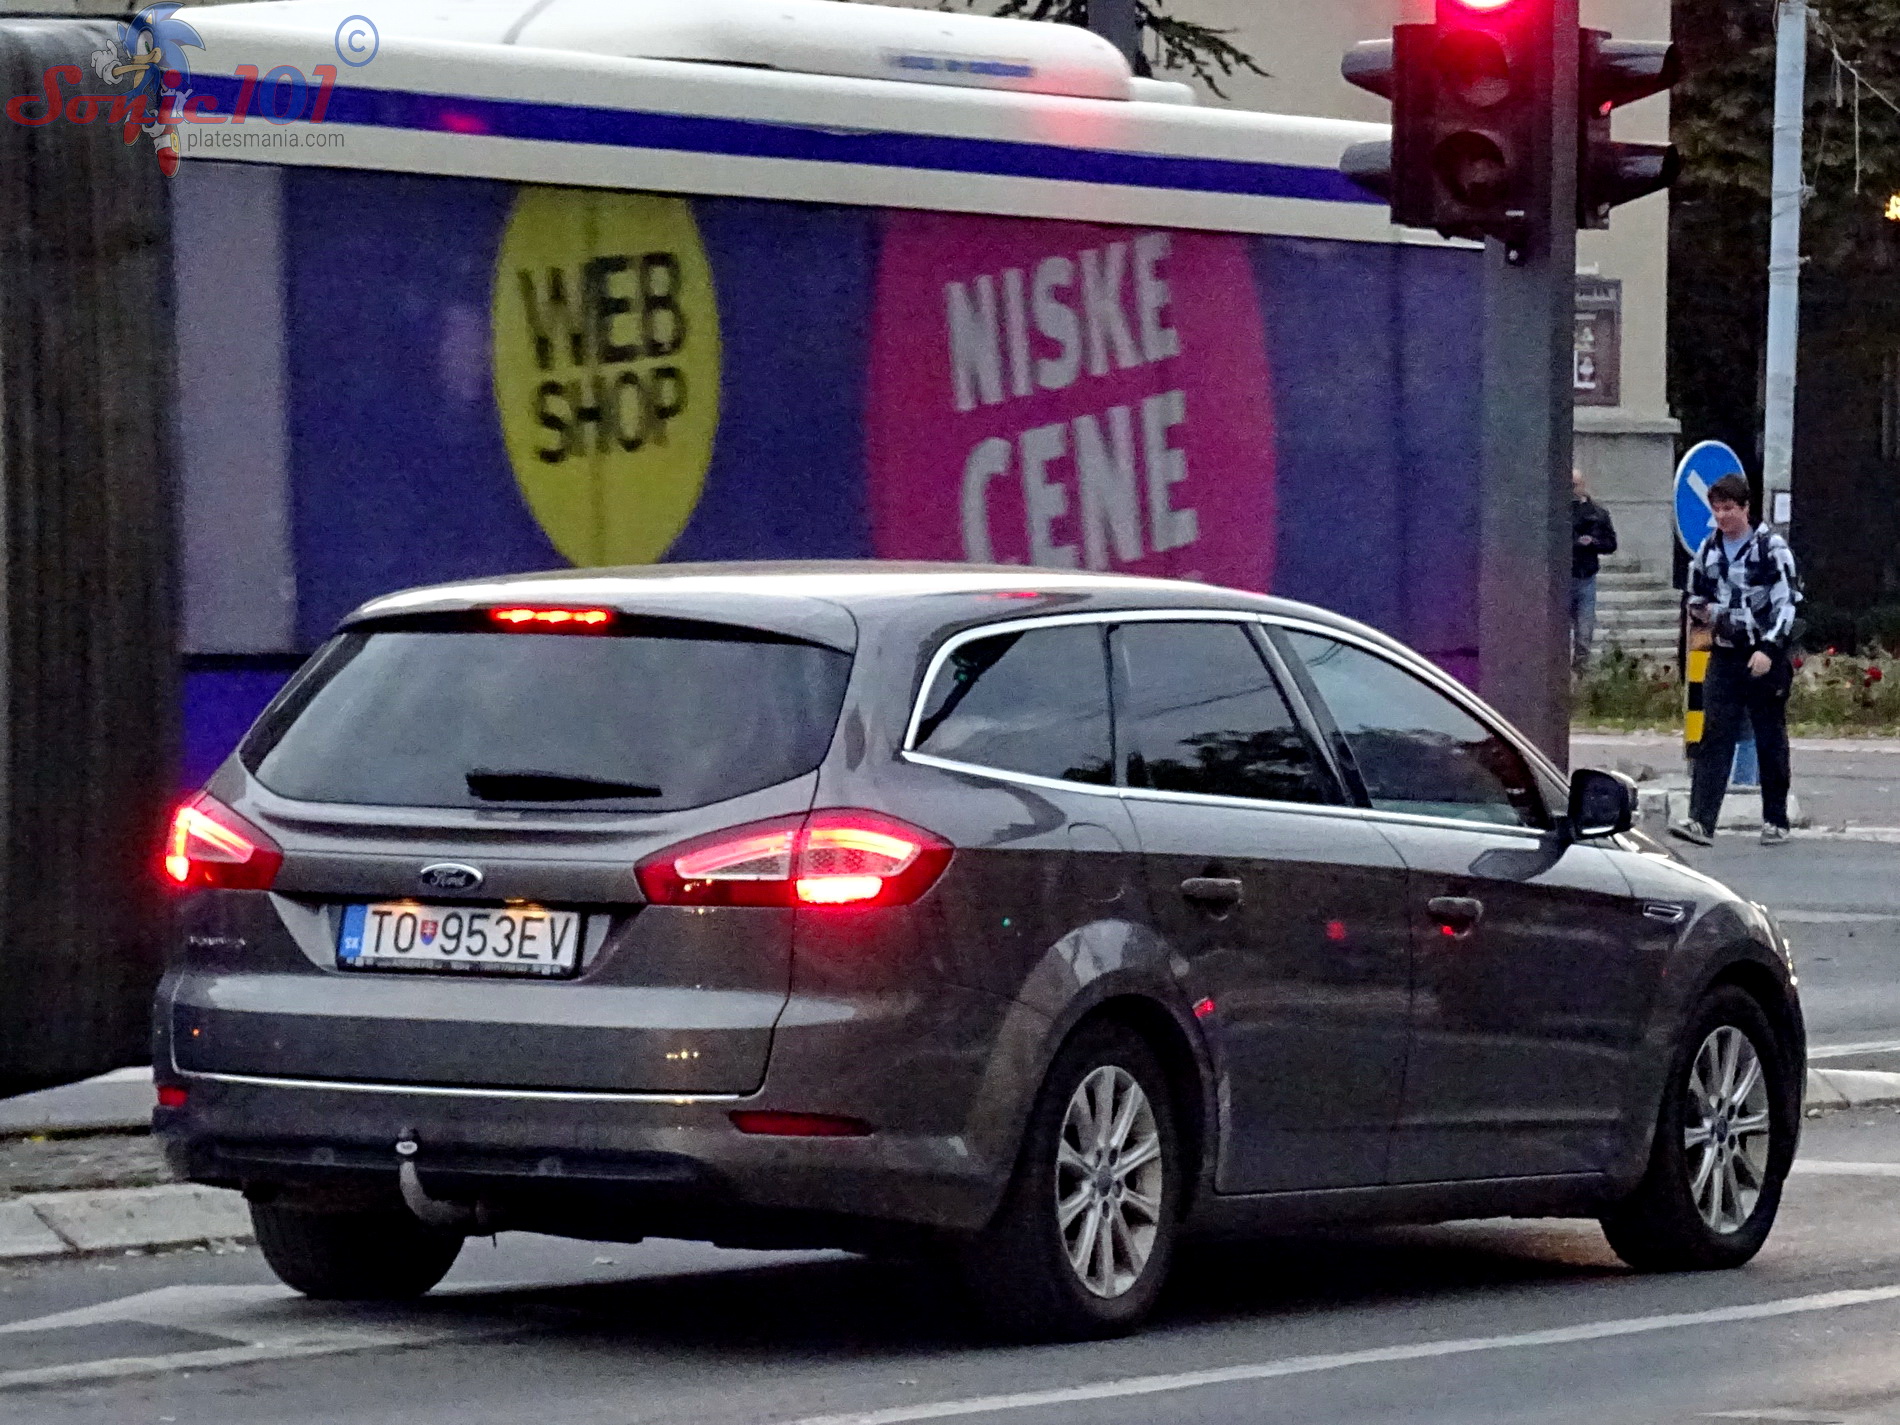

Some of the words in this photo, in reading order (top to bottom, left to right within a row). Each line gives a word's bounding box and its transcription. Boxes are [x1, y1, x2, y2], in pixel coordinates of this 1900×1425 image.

[516, 252, 688, 371] WEB
[945, 232, 1181, 412] NISKE
[534, 367, 688, 464] SHOP
[959, 389, 1198, 571] CENE
